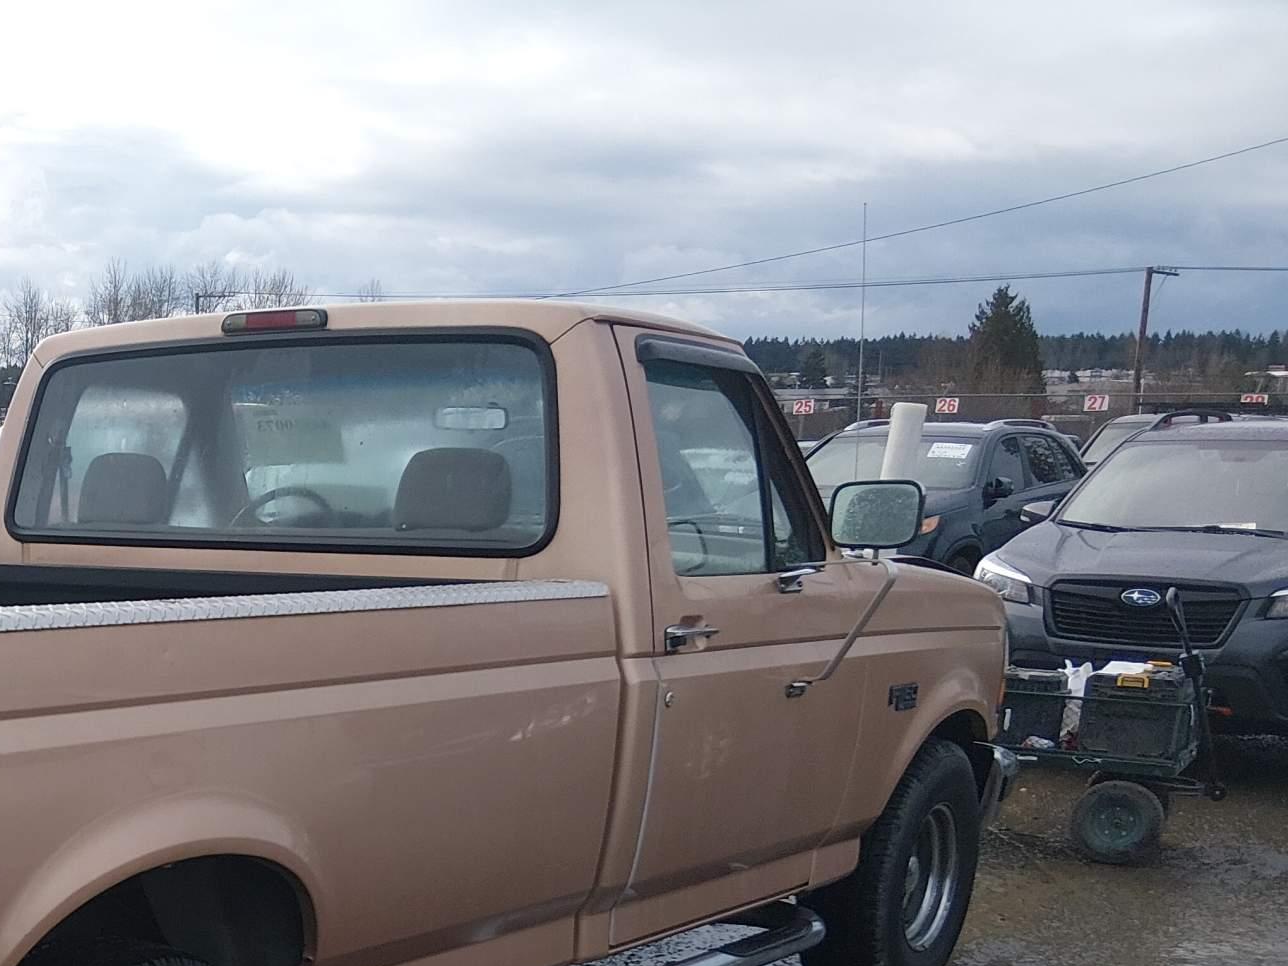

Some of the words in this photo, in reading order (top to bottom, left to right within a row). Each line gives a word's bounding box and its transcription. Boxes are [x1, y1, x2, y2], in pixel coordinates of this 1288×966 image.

[795, 400, 812, 414] 25
[937, 399, 957, 412] 26
[1087, 396, 1106, 411] 27
